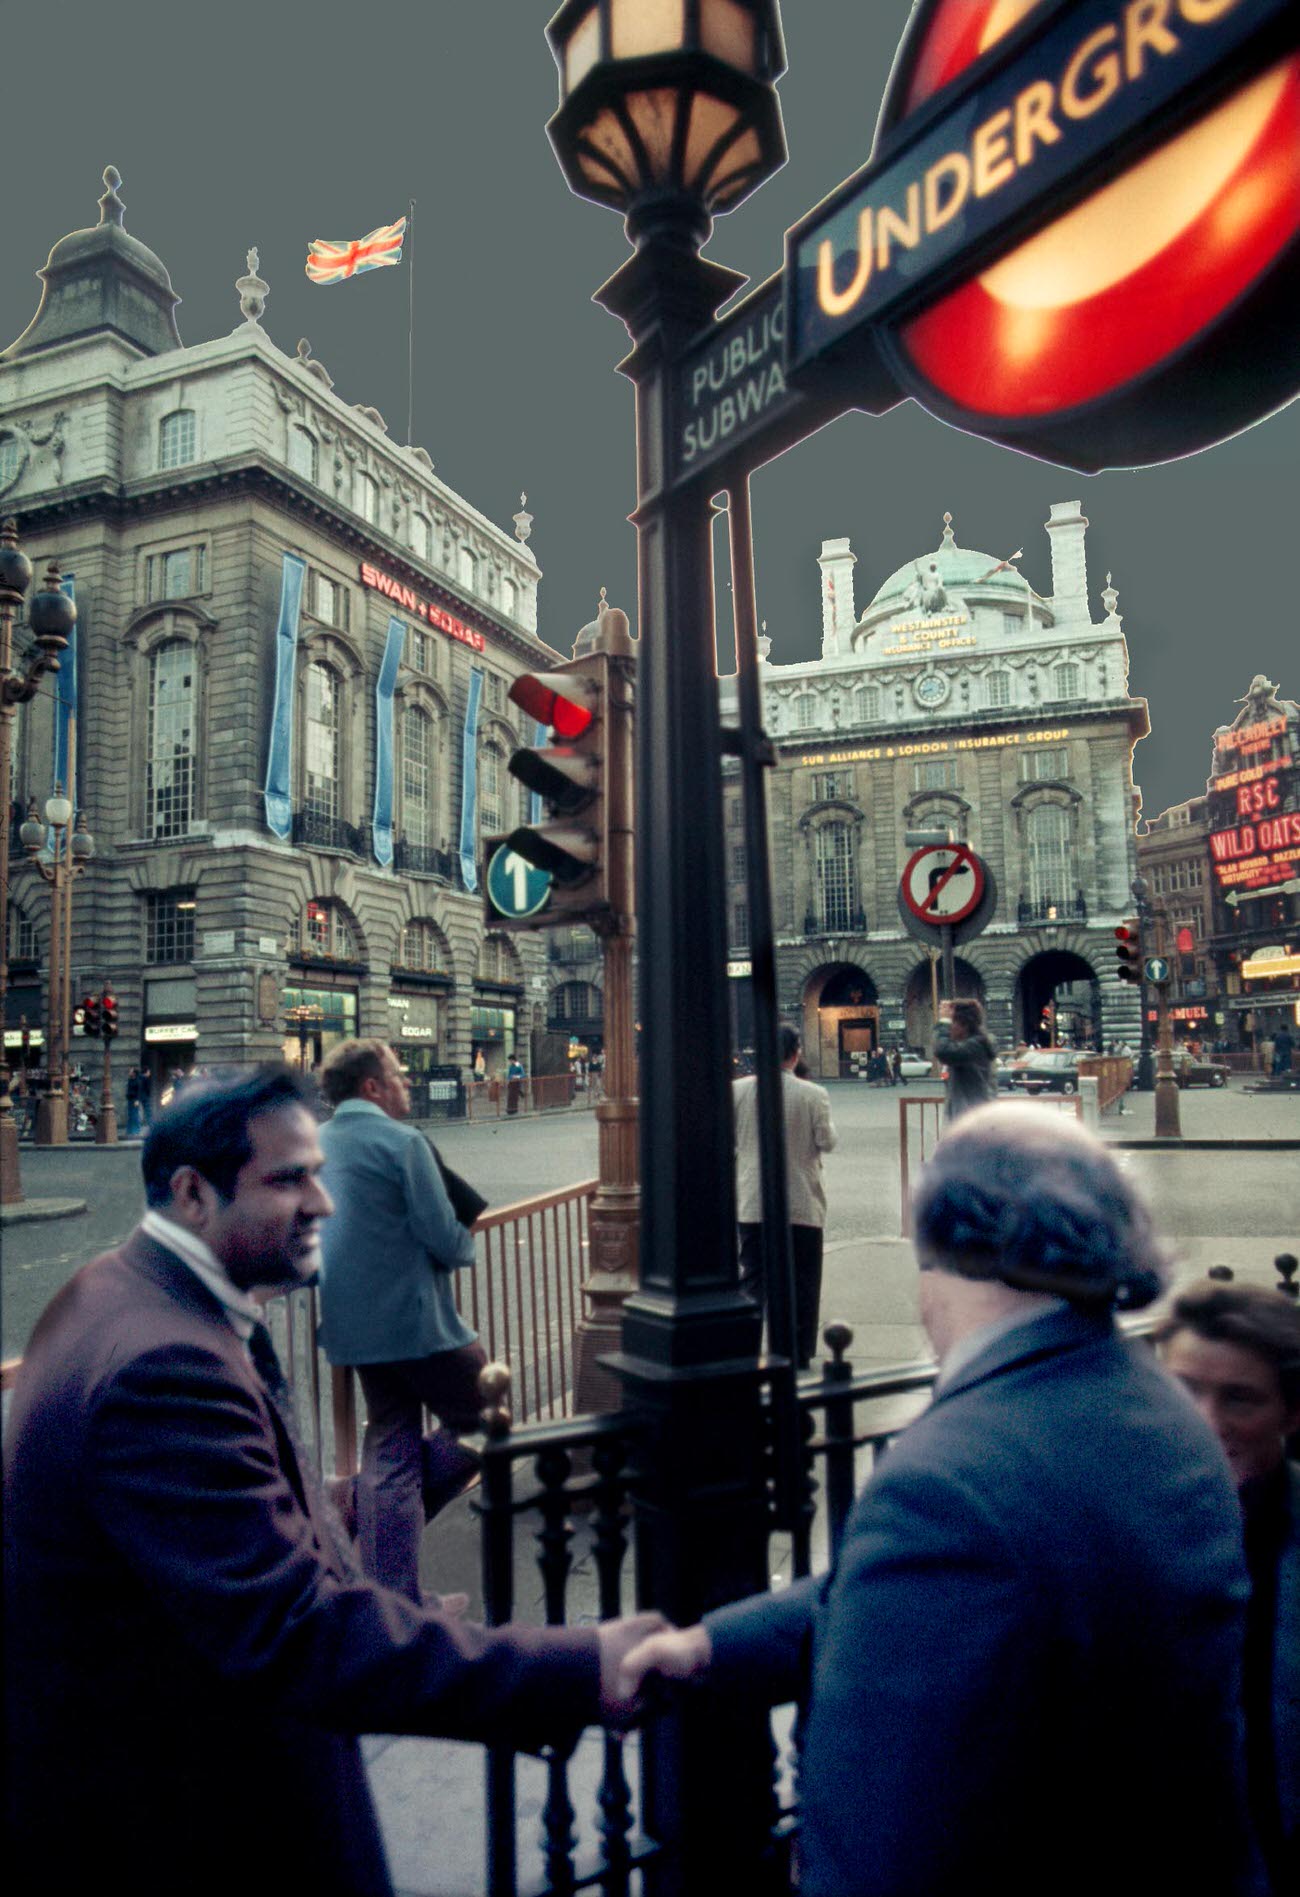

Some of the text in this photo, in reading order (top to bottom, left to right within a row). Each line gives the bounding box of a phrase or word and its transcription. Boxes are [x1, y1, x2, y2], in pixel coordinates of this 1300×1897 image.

[817, 0, 1242, 317] UNDERGR
[693, 301, 786, 406] PUBLIC
[683, 361, 786, 461] SUBWA
[361, 562, 416, 611] SWAN
[428, 603, 486, 653] EDGAR
[890, 614, 968, 634] WESTMINSTER
[913, 628, 958, 642] COUNTY
[802, 755, 824, 767] SUN
[829, 747, 881, 763] ALLIANCE
[898, 741, 949, 756] LONDON
[954, 733, 1020, 749] INSURANCE
[1026, 728, 1069, 743] GROUP
[1217, 714, 1288, 752] PICCADILLY
[1237, 777, 1279, 815] RSC
[1210, 813, 1300, 861] WILD OATS
[387, 997, 409, 1009] WAN
[1168, 1006, 1208, 1020] AMUEL
[401, 1026, 432, 1037] EDGAR
